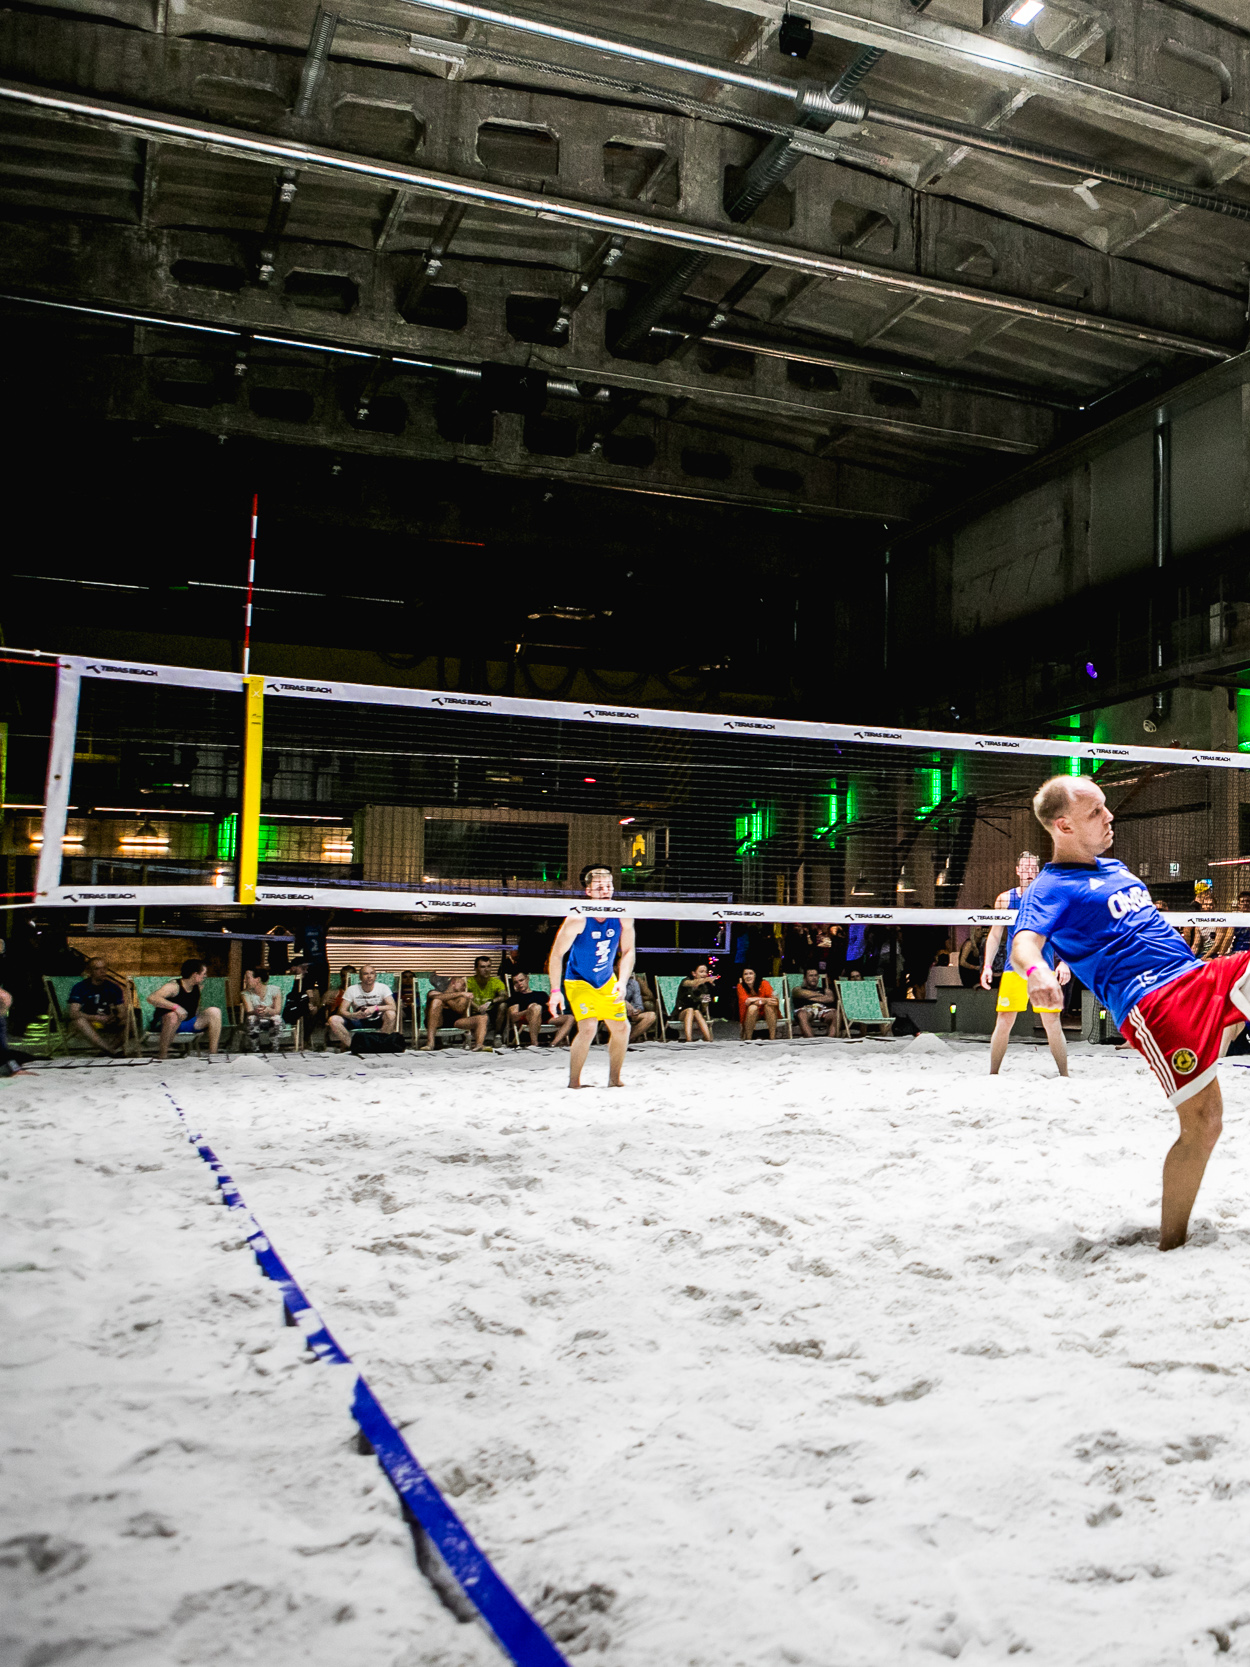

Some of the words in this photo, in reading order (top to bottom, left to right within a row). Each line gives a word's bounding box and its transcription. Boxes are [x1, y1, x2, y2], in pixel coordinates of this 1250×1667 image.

[100, 665, 128, 674] TERAS
[129, 668, 158, 676] BEACH
[580, 1003, 588, 1014] 5
